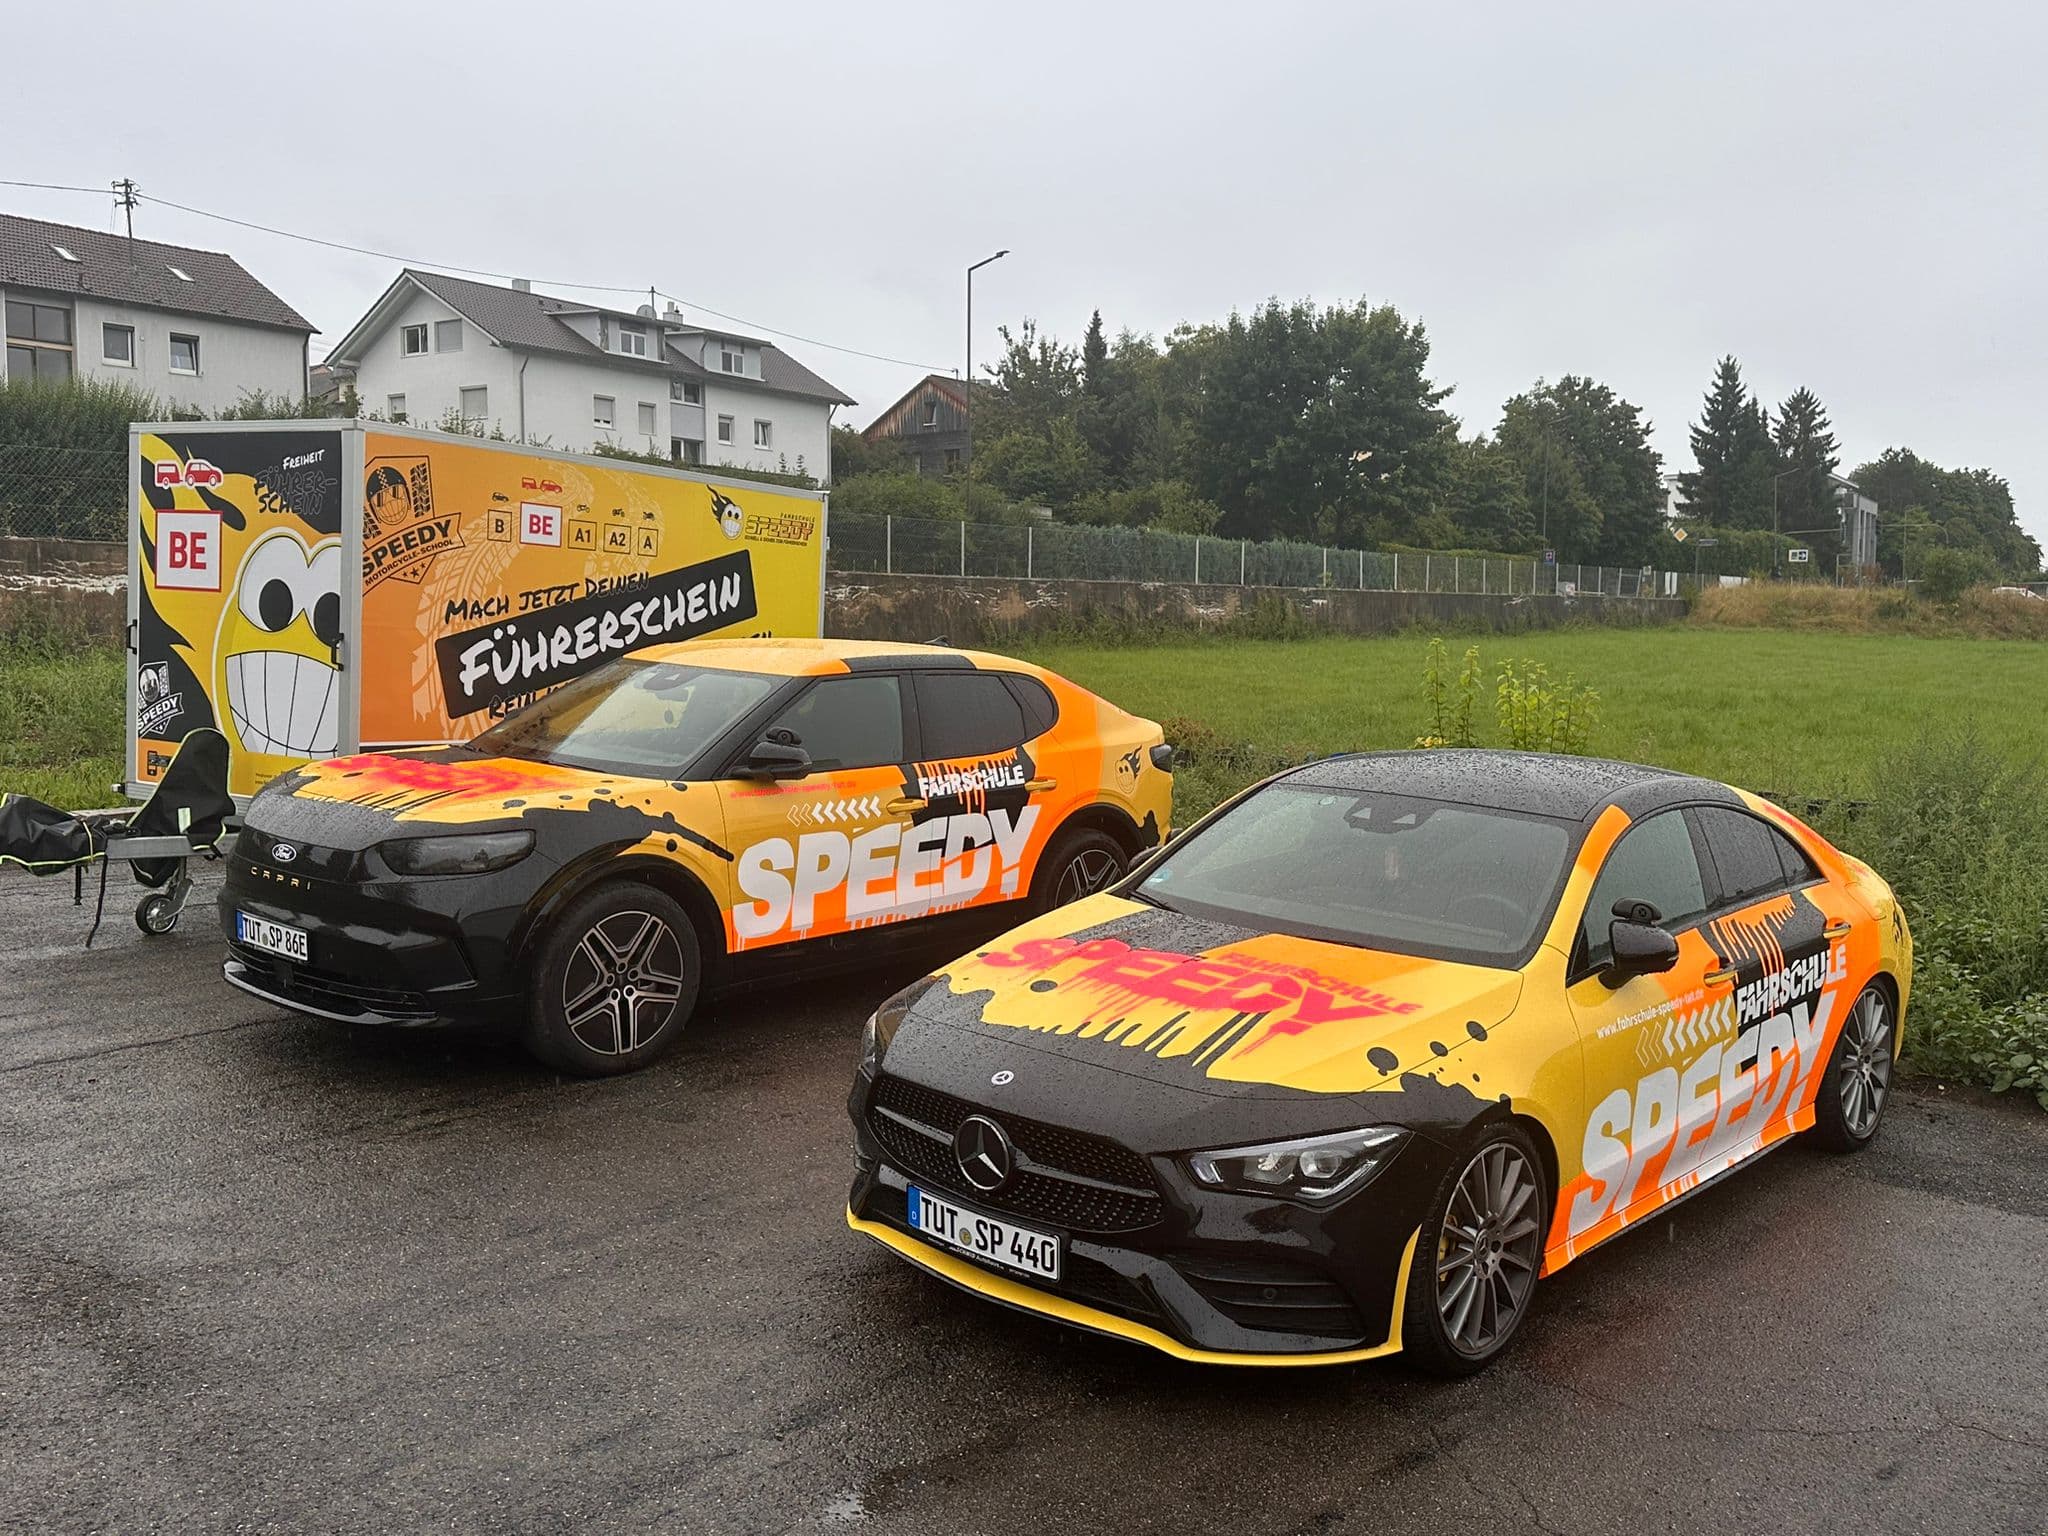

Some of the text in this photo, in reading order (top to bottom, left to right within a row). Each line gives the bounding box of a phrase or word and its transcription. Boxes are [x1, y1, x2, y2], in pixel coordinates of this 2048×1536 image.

[283, 449, 325, 470] FREIHEIT
[495, 518, 504, 533] B
[529, 514, 553, 536] BE
[575, 528, 591, 543] A1
[609, 532, 626, 547] A2
[643, 536, 652, 549] A
[745, 515, 814, 541] SPEEDY
[169, 531, 207, 569] BE
[363, 519, 451, 577] SPEEDY
[365, 539, 454, 586] MOTORCYCLE-SCHOOL
[445, 571, 650, 624] MACH JETZT DEINEN
[459, 572, 741, 696] FÜHRERSCHEIN
[138, 697, 178, 730] SPEEDY
[918, 765, 1025, 798] FAHRSCHULE
[250, 866, 311, 890] CAPRI
[733, 804, 1040, 939] SPEEDY
[243, 917, 306, 957] TUT SP 86E
[982, 938, 1394, 1036] SPEEDY
[1217, 952, 1423, 1016] FAHRSCHULE
[1737, 944, 1847, 1027] FAHRSCHULE
[1568, 990, 1837, 1236] SPEEDY
[921, 1196, 958, 1239] TUT
[975, 1219, 1003, 1254] SP
[1010, 1232, 1055, 1273] 440
